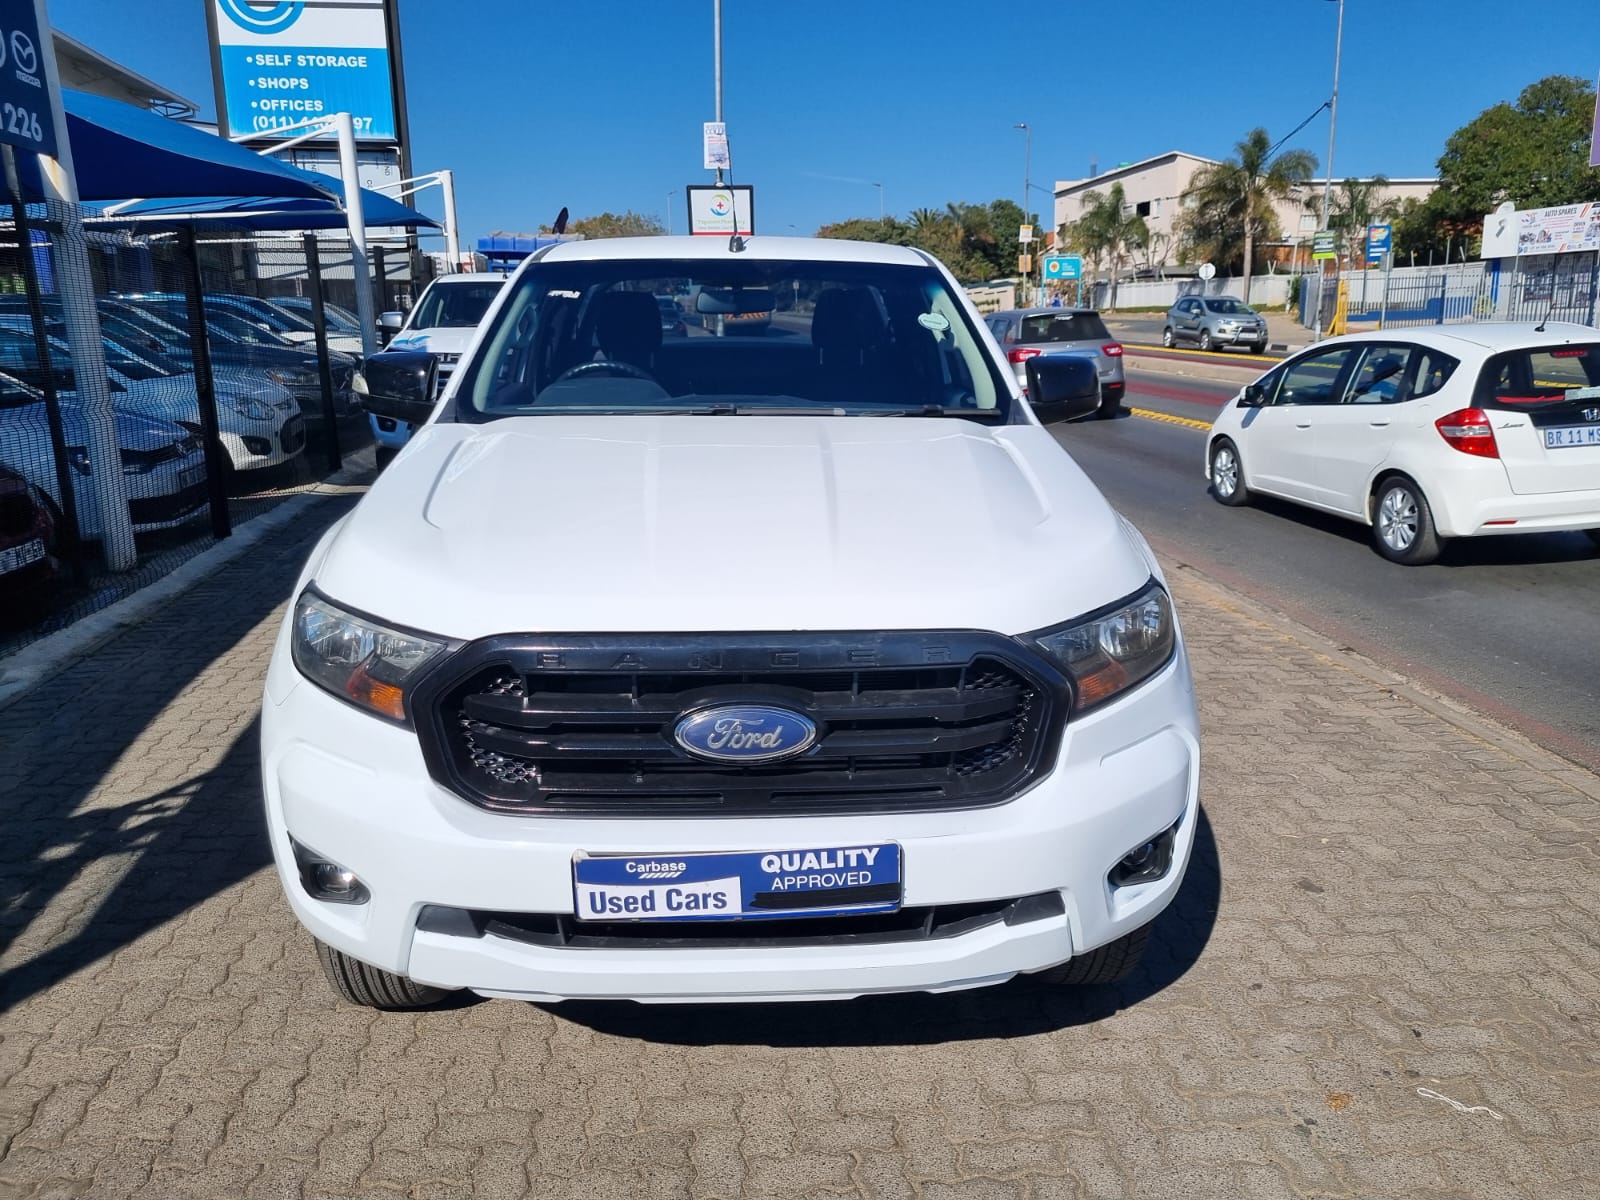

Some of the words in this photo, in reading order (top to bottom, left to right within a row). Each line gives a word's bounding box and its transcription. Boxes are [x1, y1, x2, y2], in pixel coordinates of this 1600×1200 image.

[255, 54, 293, 66] SELF
[297, 55, 367, 67] STORAGE
[258, 77, 309, 89] SHOPS
[260, 99, 323, 111] OFFICES
[253, 115, 294, 131] (011)
[1544, 209, 1558, 217] AUTO
[1558, 207, 1578, 216] SPARES
[1548, 431, 1562, 445] BR
[1568, 430, 1583, 444] 11
[536, 646, 953, 670] RANGER
[707, 718, 782, 751] Ford
[625, 860, 687, 874] Carbase
[760, 847, 880, 873] QUALITY
[771, 871, 872, 891] APPROVED
[589, 889, 656, 914] Used
[665, 886, 728, 912] Cars
